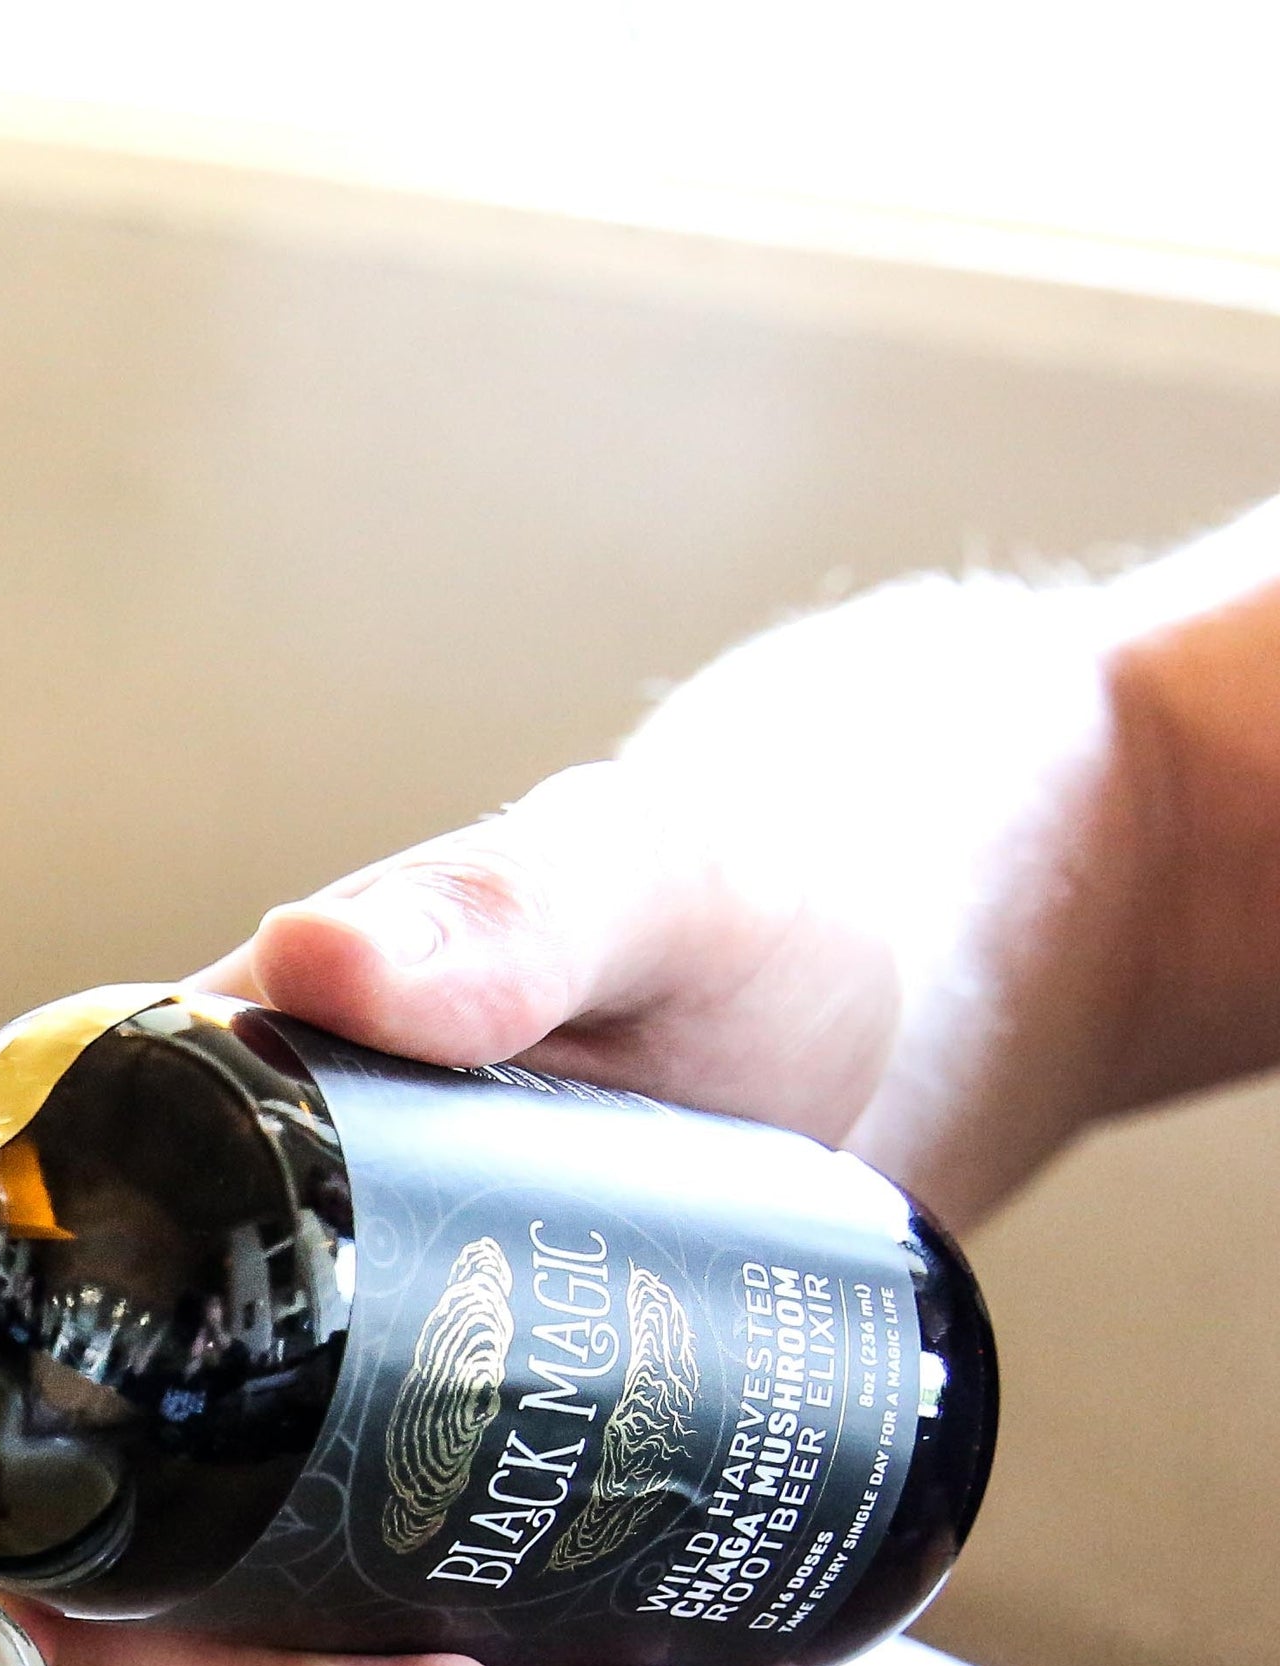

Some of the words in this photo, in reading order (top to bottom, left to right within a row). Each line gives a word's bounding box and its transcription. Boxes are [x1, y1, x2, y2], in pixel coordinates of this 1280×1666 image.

[880, 1286, 900, 1324] LIFE
[858, 1320, 879, 1366] (236
[886, 1330, 901, 1389] MAGIC
[426, 1430, 586, 1590] BLACK
[518, 1219, 621, 1422] MAGIC
[857, 1371, 876, 1409] 8oz
[886, 1392, 900, 1406] A
[636, 1531, 719, 1613] WILD
[707, 1261, 773, 1518] HARVESTED
[669, 1512, 766, 1619] CHAGA
[747, 1265, 807, 1497] MUSHROOM
[702, 1426, 827, 1622] ROOTBEER
[804, 1273, 836, 1409] ELIXIR
[879, 1408, 899, 1446] FOR
[869, 1450, 892, 1487] DAY
[842, 1490, 879, 1551] SINGLE
[770, 1592, 796, 1612] 16
[787, 1531, 834, 1590] DOSES
[808, 1552, 849, 1600] EVERY
[777, 1602, 815, 1633] TAKE
